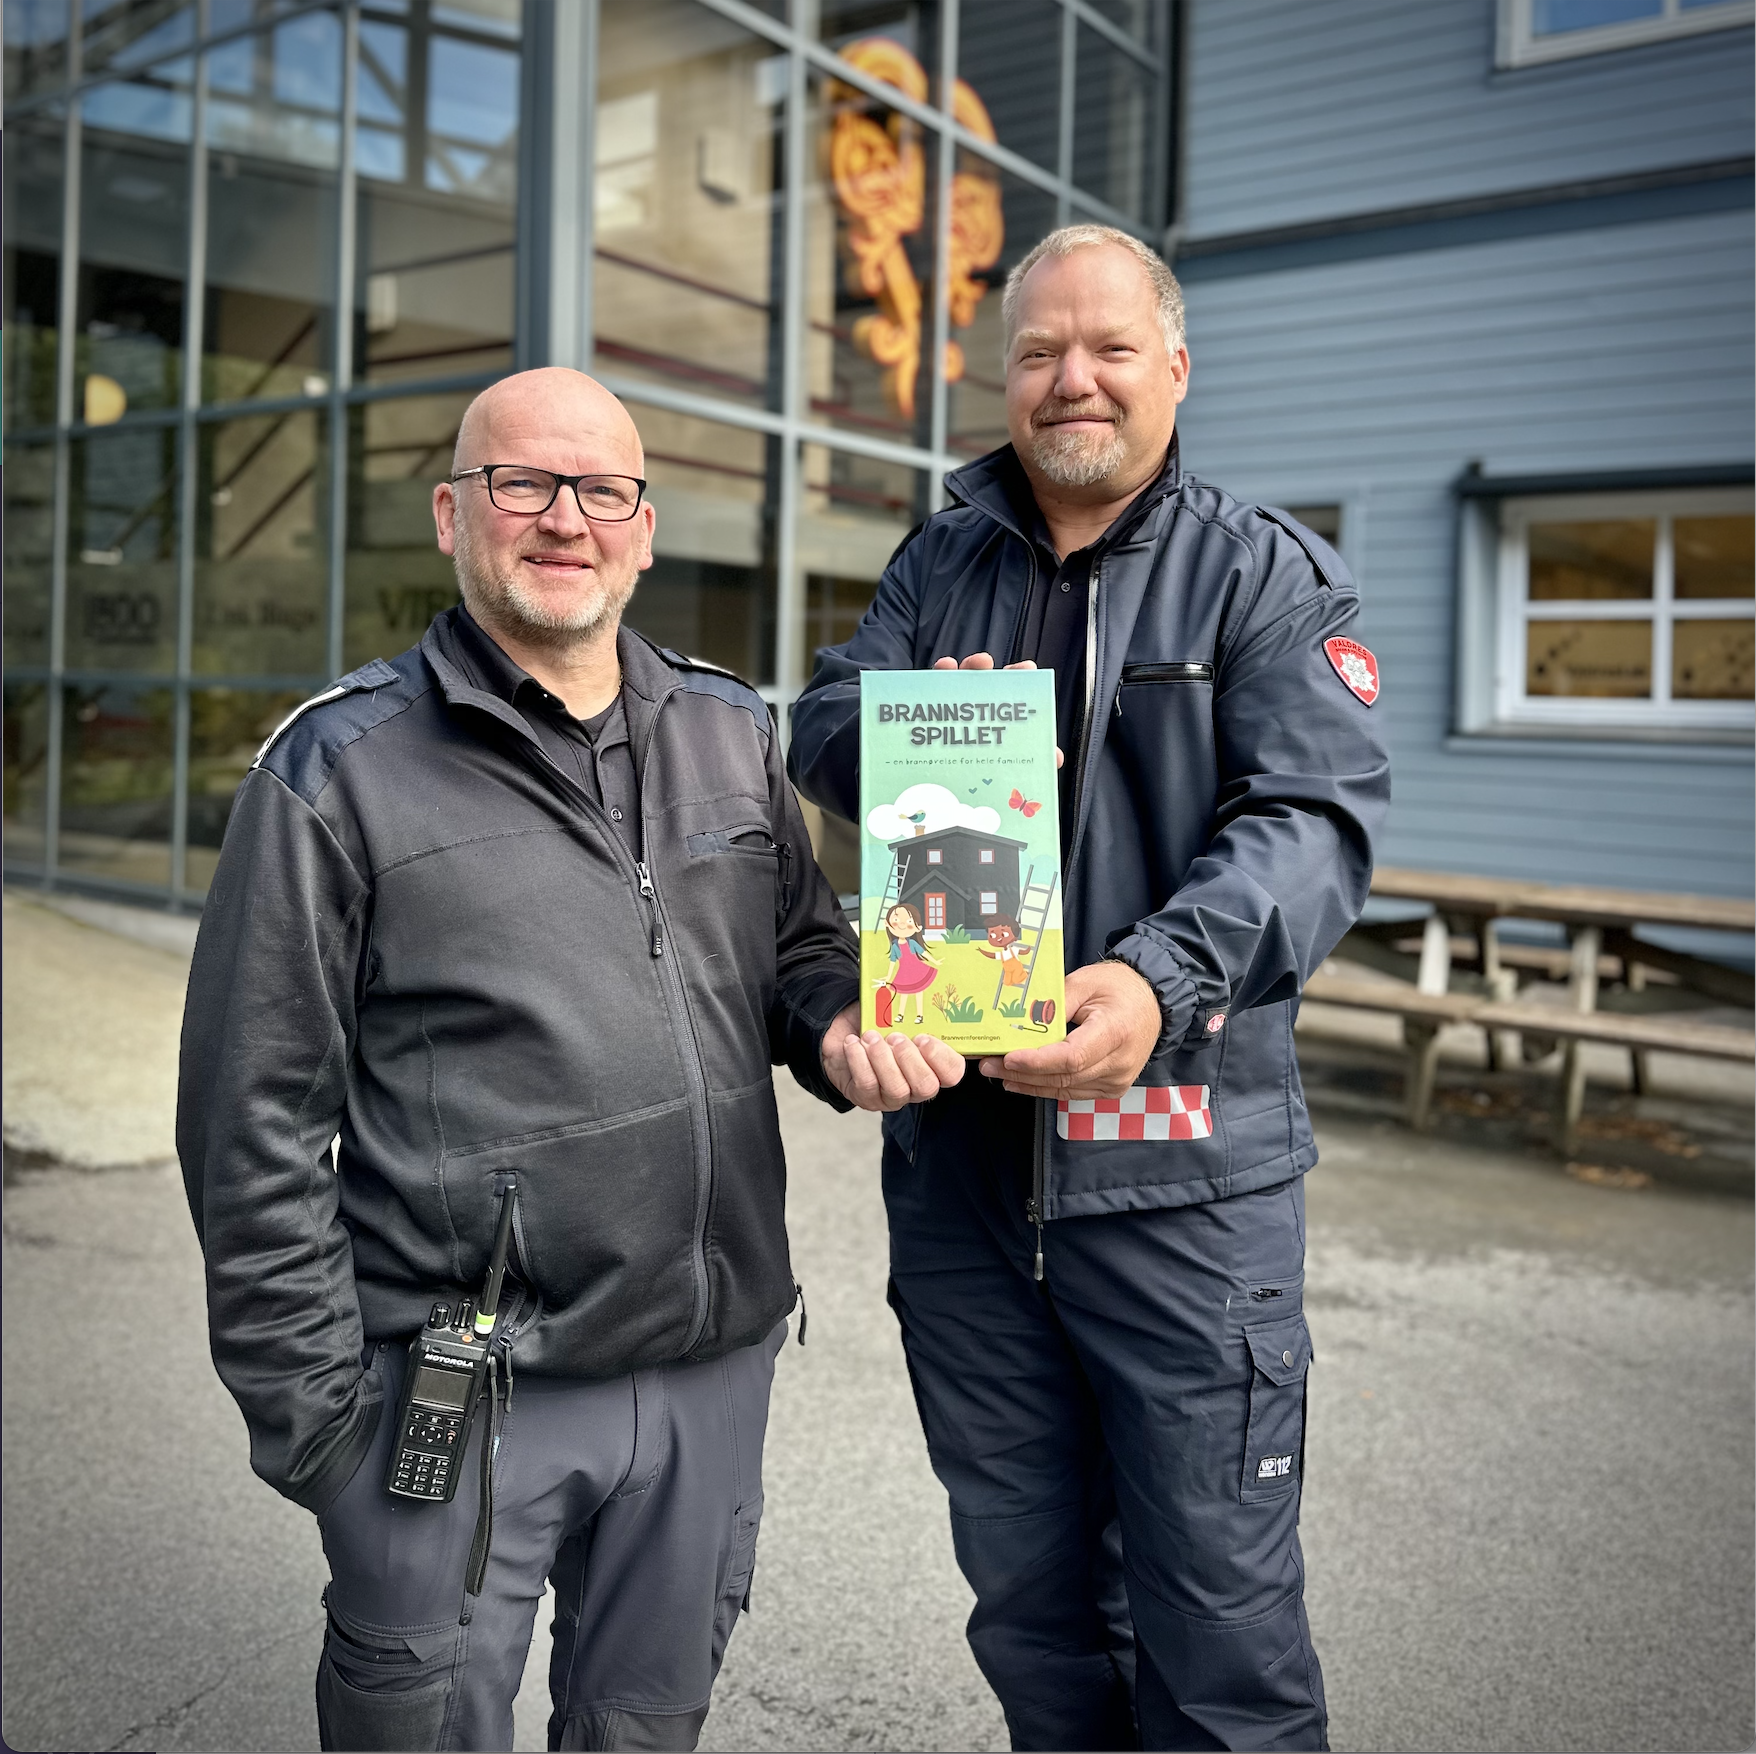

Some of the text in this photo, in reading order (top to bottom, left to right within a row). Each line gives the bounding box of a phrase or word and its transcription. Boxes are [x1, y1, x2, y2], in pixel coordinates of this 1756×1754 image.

[879, 702, 1036, 722] BRANNSTIGE-
[910, 726, 1006, 746] SPILLET
[906, 758, 957, 766] brannøvelse
[960, 757, 973, 765] for
[976, 757, 994, 765] hele
[997, 757, 1034, 765] familien!
[424, 1353, 474, 1368] MOTOROLA
[1277, 1455, 1292, 1476] 112
